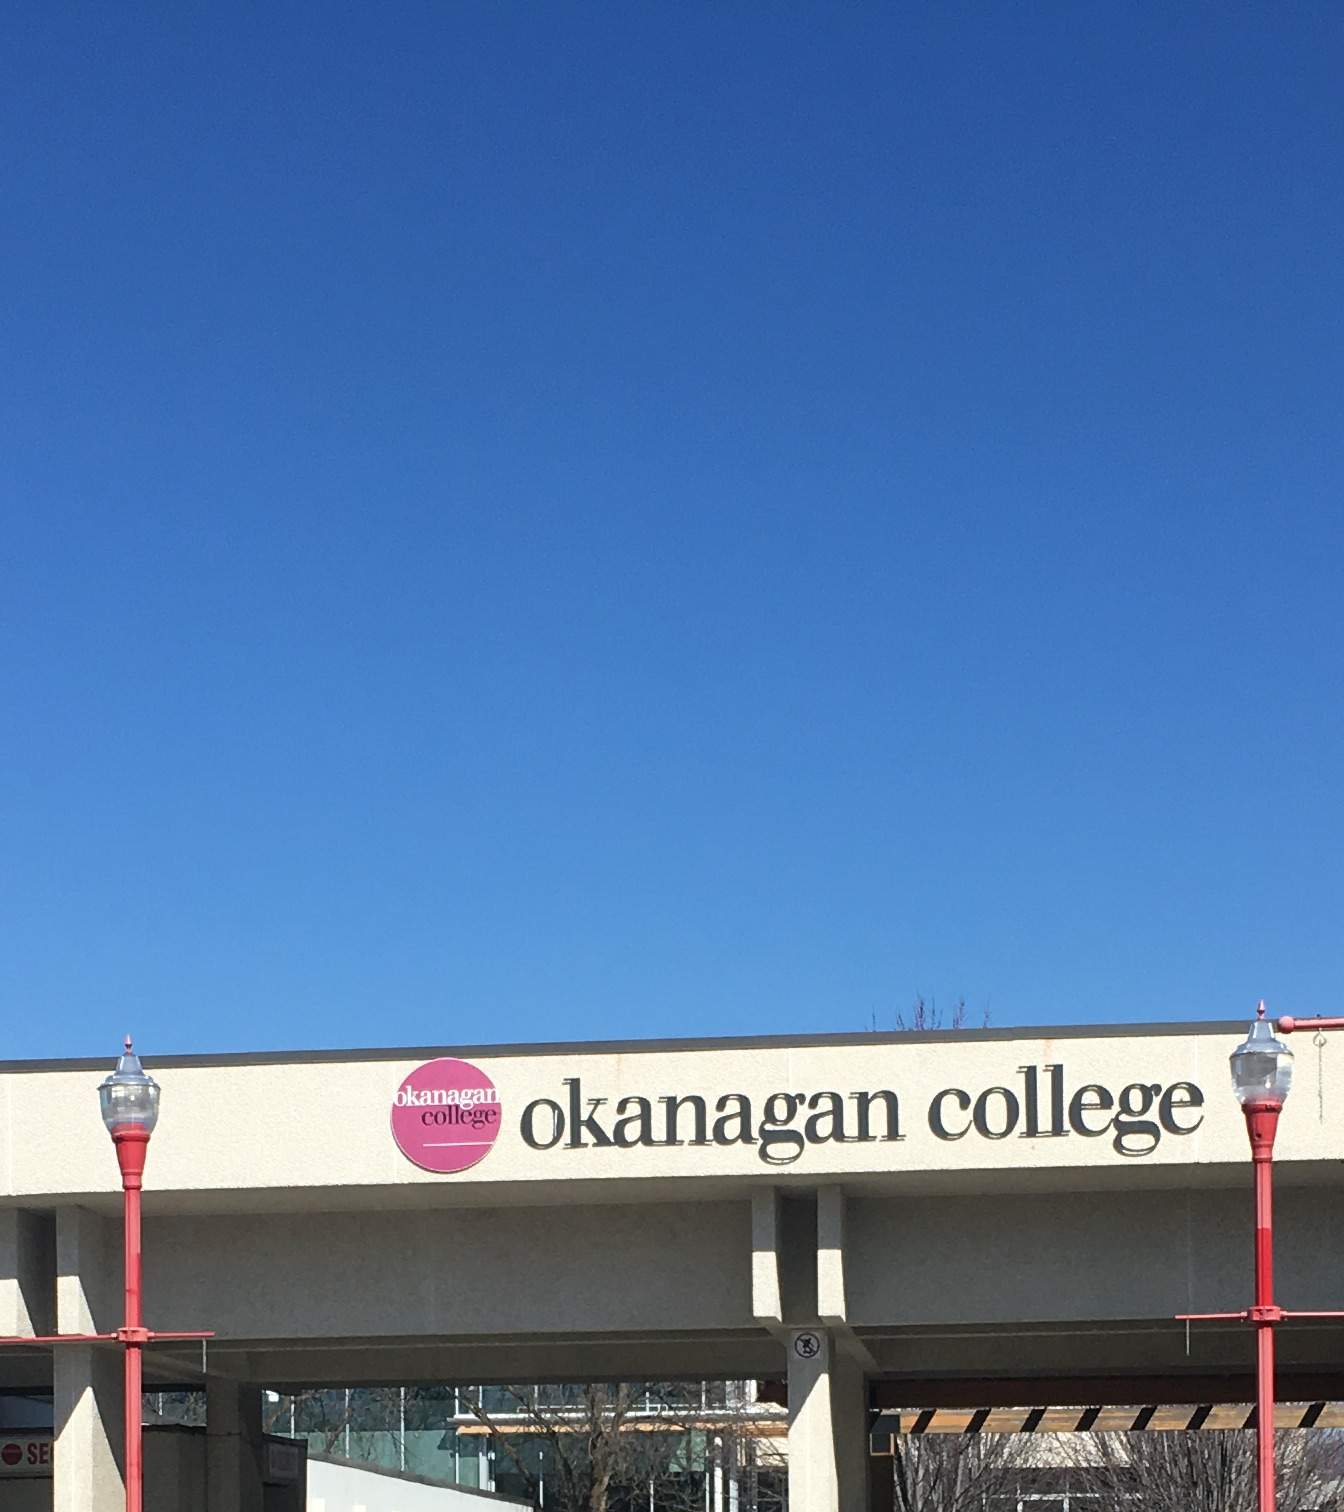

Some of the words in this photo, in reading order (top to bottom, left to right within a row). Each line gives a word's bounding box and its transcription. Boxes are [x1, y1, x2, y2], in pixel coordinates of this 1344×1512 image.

[394, 1085, 501, 1110] okanagan
[421, 1104, 497, 1130] college
[520, 1077, 907, 1166] okanagan
[928, 1063, 1205, 1158] college
